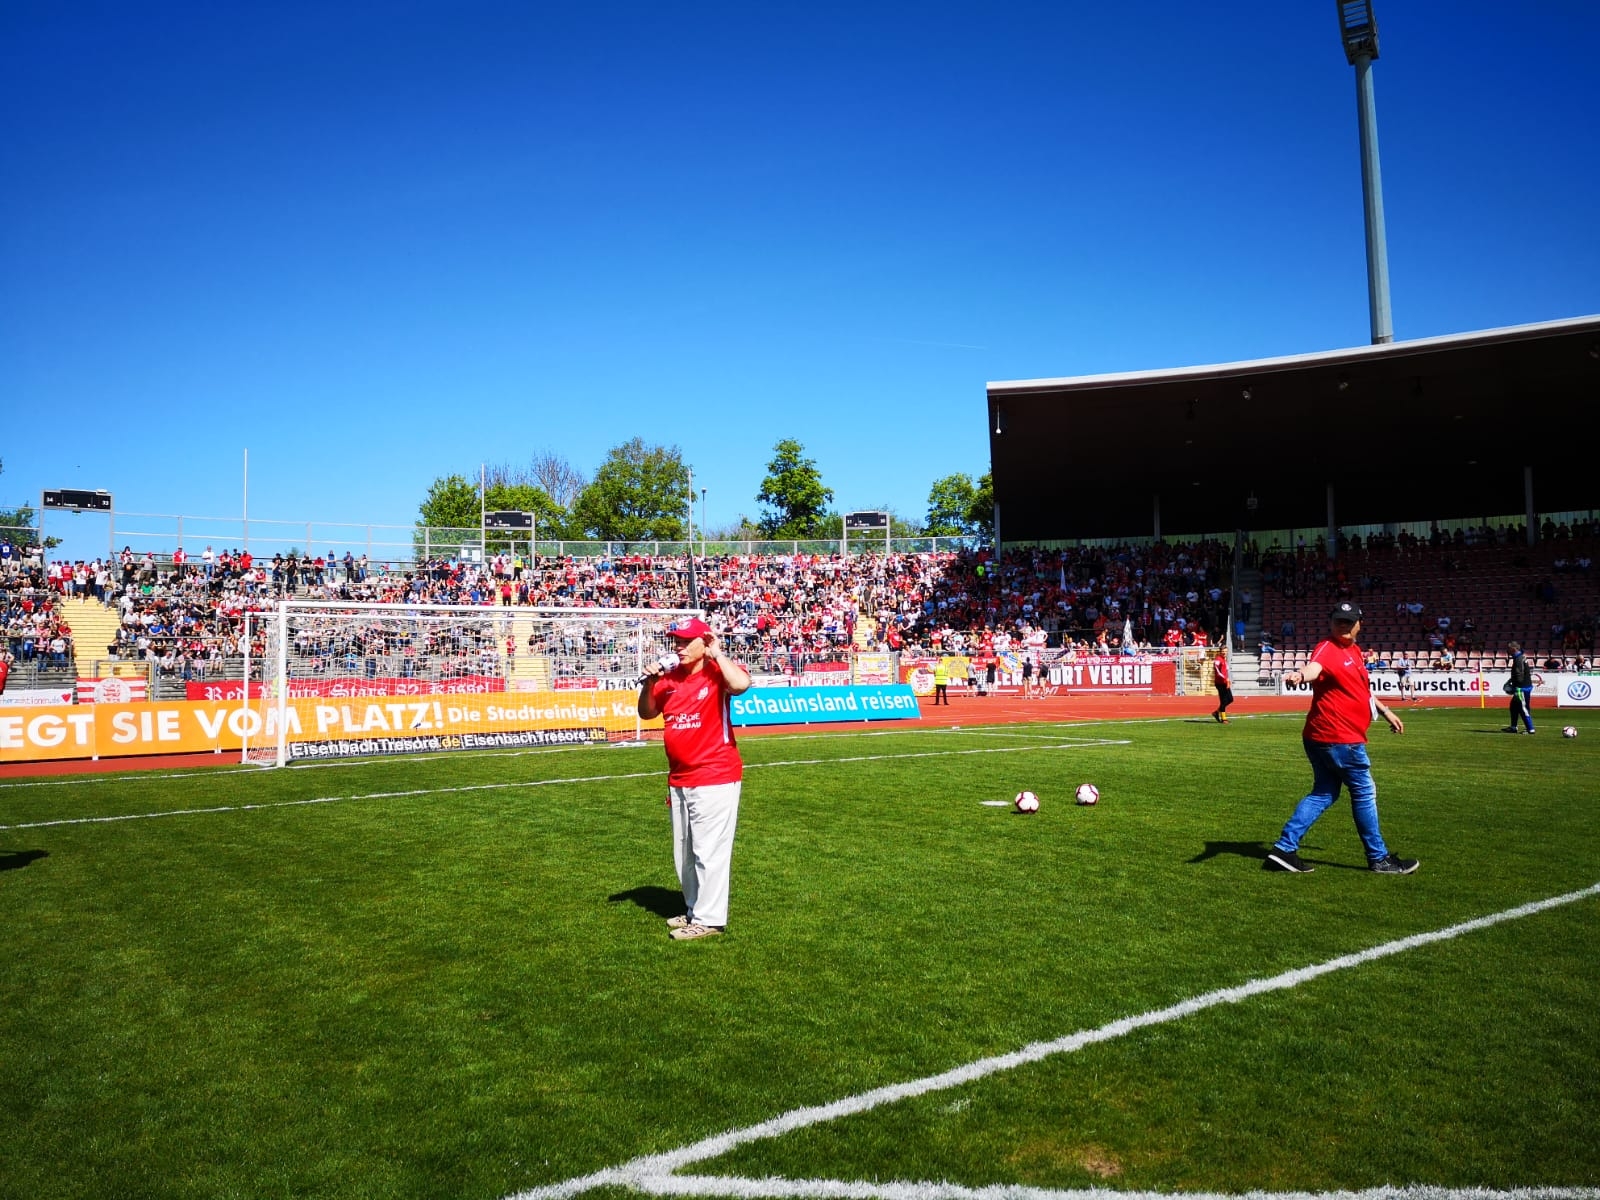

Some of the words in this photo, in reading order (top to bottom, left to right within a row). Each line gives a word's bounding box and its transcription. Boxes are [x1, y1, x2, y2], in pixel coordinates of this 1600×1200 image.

[1089, 664, 1153, 686] VEREIN
[429, 681, 491, 695] Kassel
[733, 692, 858, 715] schauinsland
[861, 690, 915, 710] reisen
[111, 710, 180, 743] SIE
[193, 706, 303, 738] VOM
[315, 701, 444, 733] PLATZ!
[447, 706, 481, 723] Die
[486, 703, 608, 721] Stadtreiniger
[291, 736, 460, 756] EisenbachTresore.de
[464, 728, 608, 748] EisenbachTresore.de
